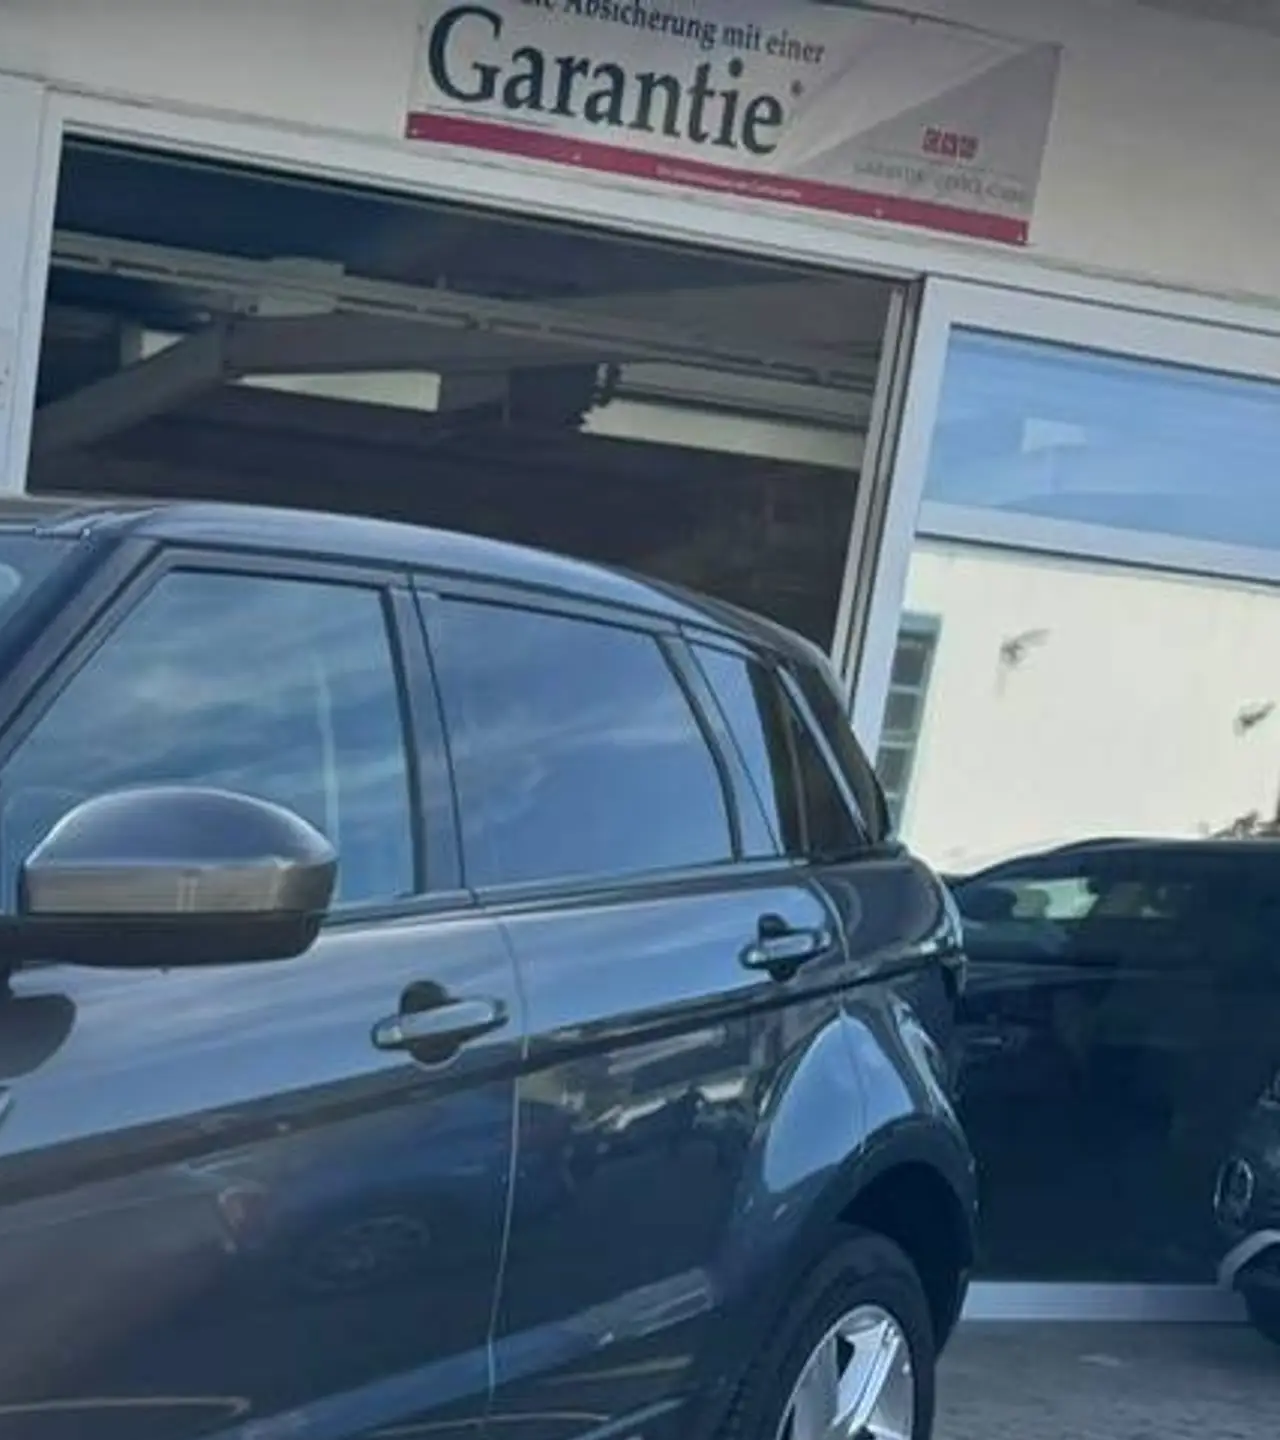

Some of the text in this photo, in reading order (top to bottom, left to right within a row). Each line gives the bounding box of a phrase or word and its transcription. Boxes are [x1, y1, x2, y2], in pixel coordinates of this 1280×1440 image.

[428, 5, 784, 155] Garantie
[722, 25, 761, 52] mit
[765, 33, 825, 64] einer
